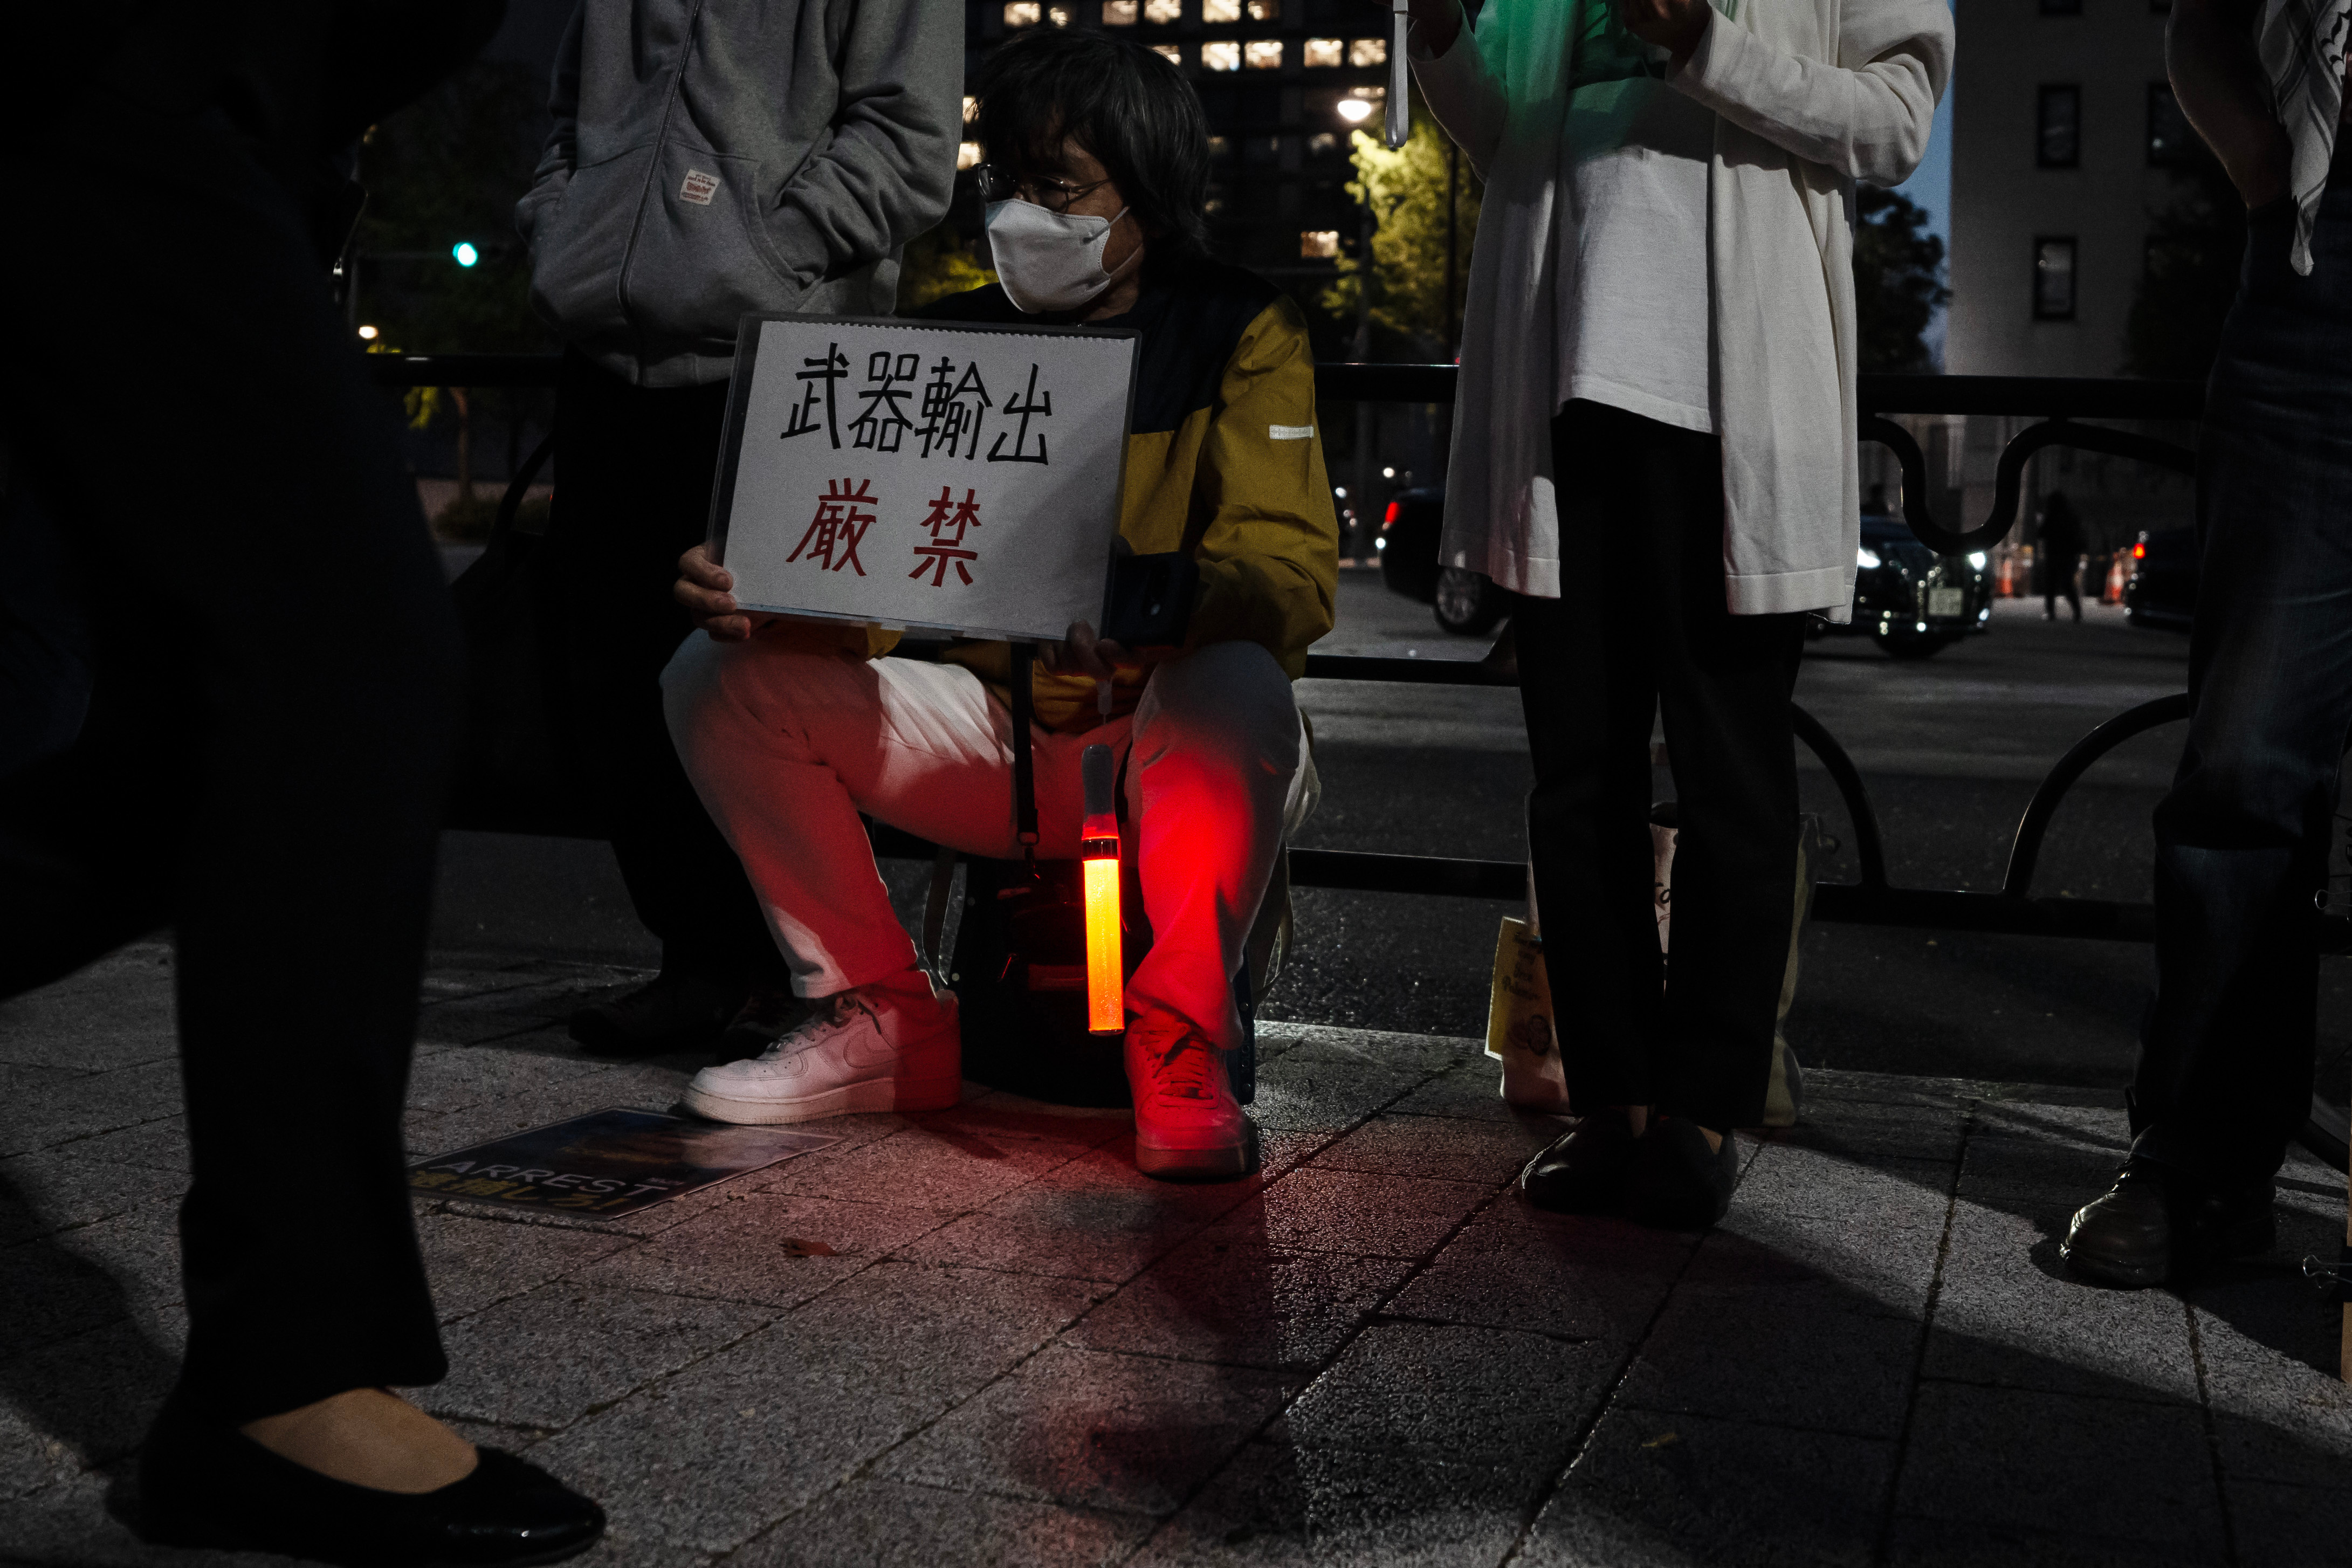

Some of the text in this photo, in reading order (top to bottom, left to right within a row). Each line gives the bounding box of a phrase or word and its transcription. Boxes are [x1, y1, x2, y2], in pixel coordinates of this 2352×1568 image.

[781, 342, 1052, 465] 武器輸出
[786, 478, 982, 587] 厳禁
[428, 1161, 669, 1196] ARREST
